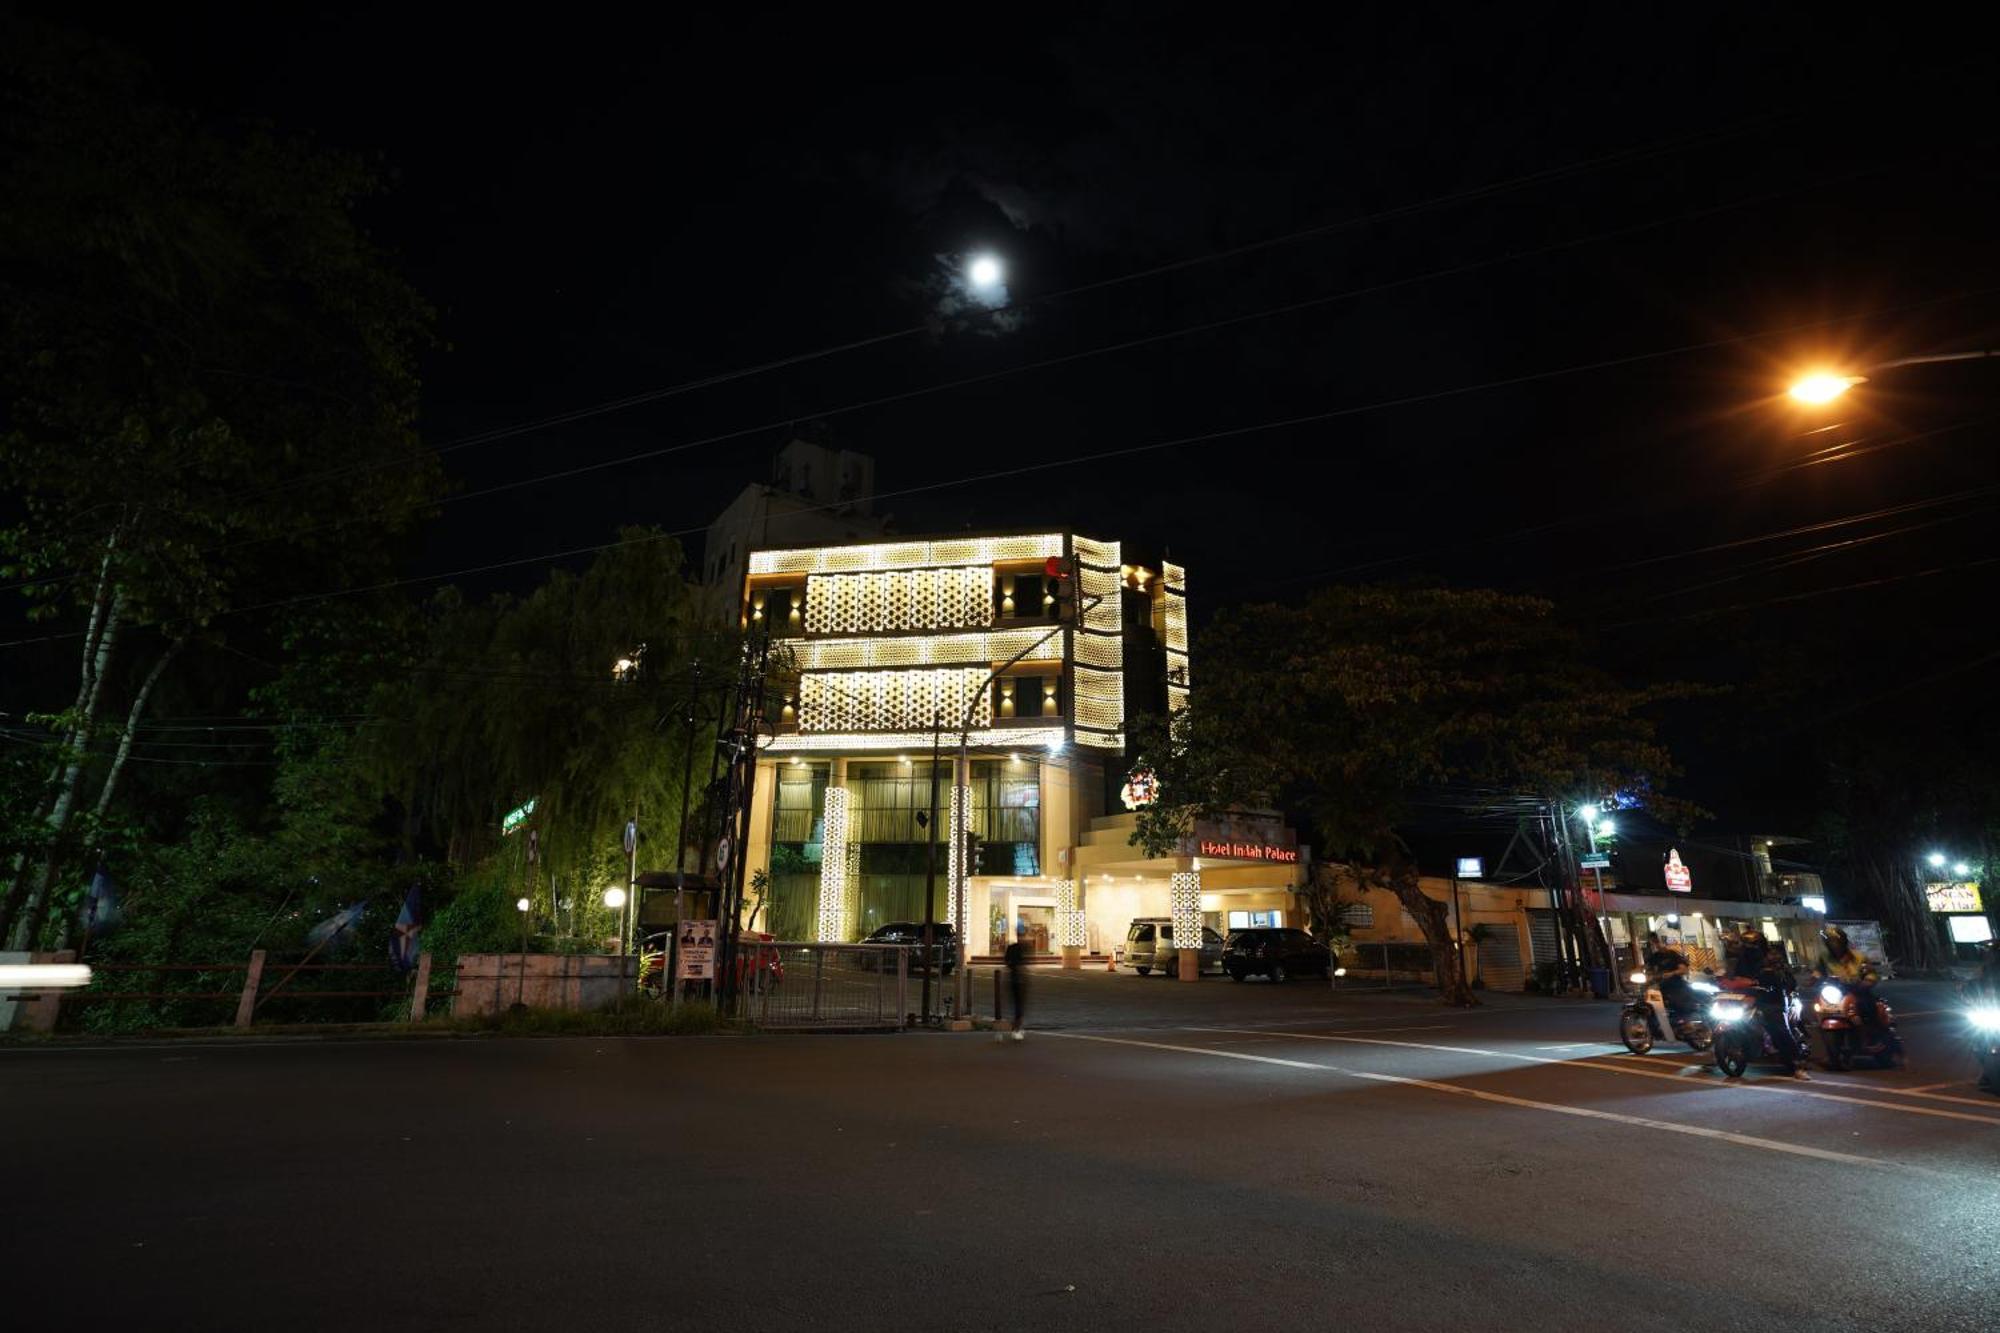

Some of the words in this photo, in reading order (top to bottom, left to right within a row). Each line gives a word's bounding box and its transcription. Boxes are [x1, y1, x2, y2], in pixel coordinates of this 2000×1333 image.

[1201, 841, 1230, 856] Hotel
[1233, 843, 1262, 858] Indah
[1265, 846, 1296, 861] Palace
